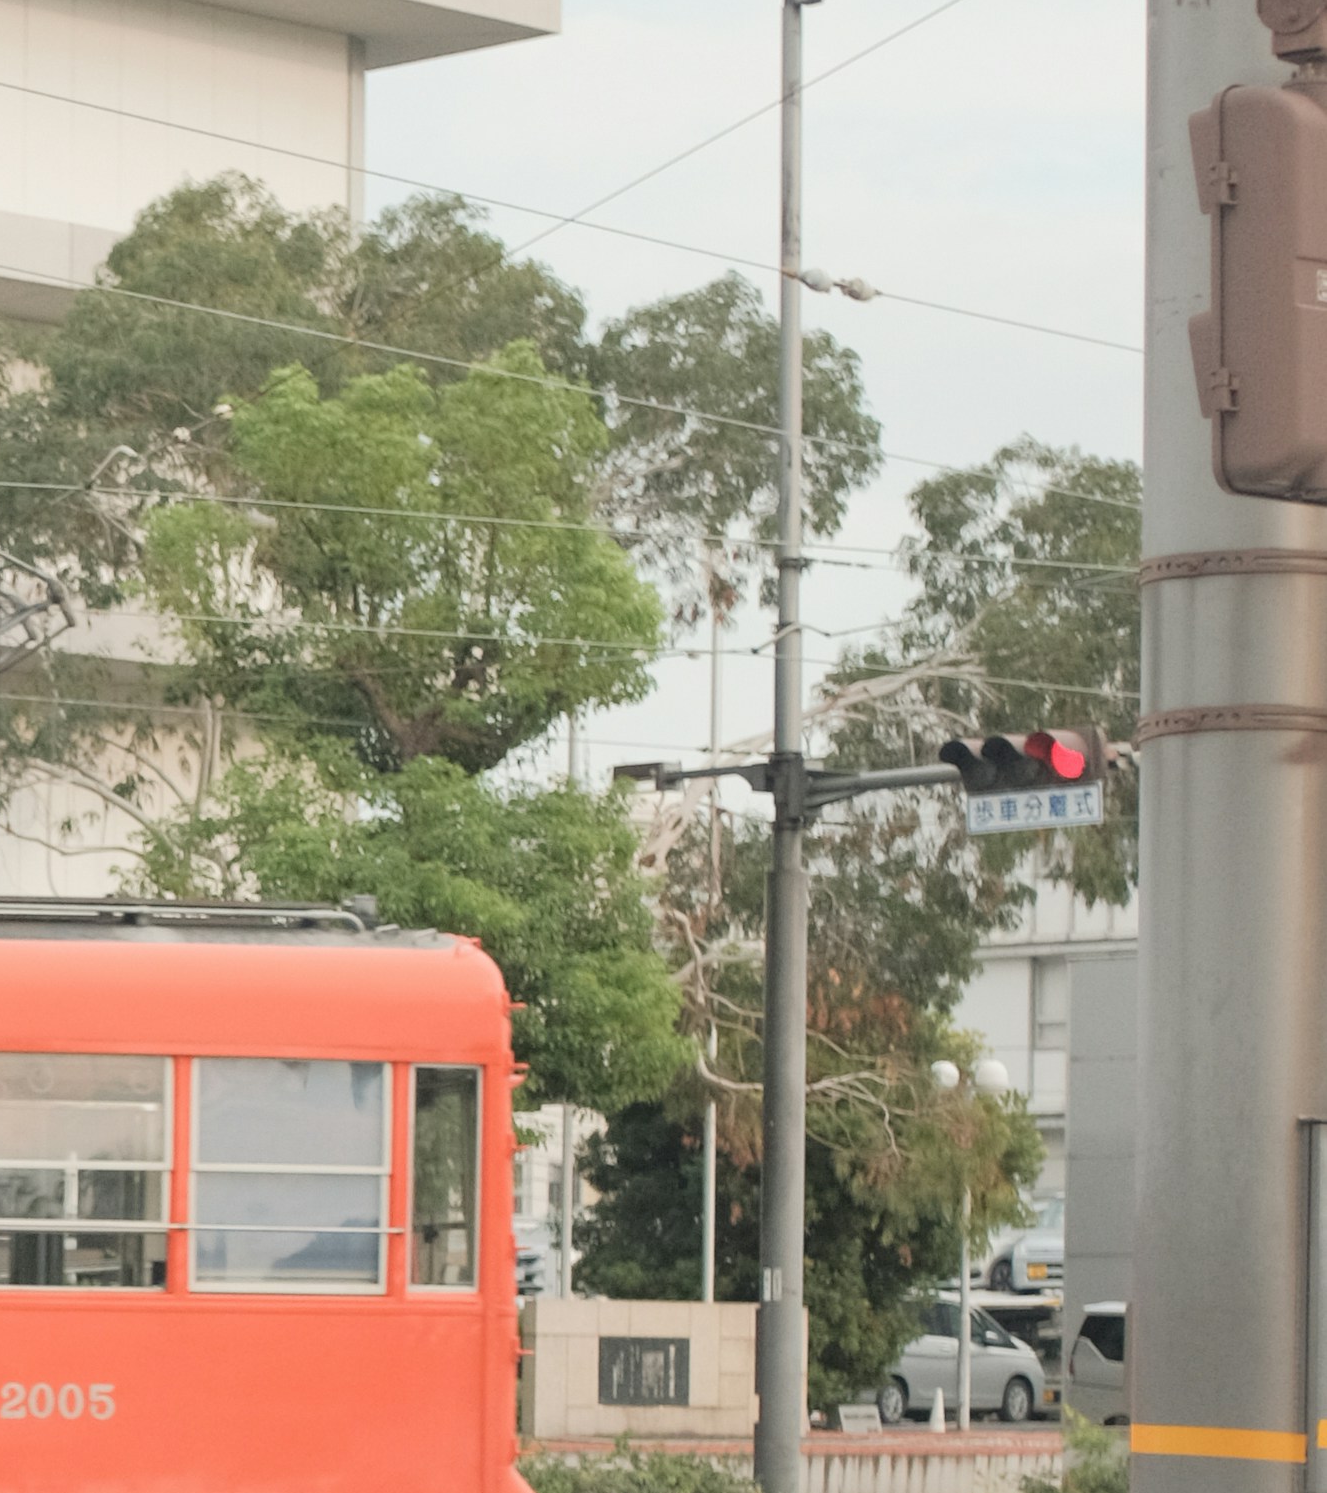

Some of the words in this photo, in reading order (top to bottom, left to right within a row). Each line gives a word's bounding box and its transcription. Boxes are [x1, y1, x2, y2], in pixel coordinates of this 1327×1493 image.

[974, 790, 1094, 824] 歩車分離式
[0, 1381, 116, 1422] 2005
